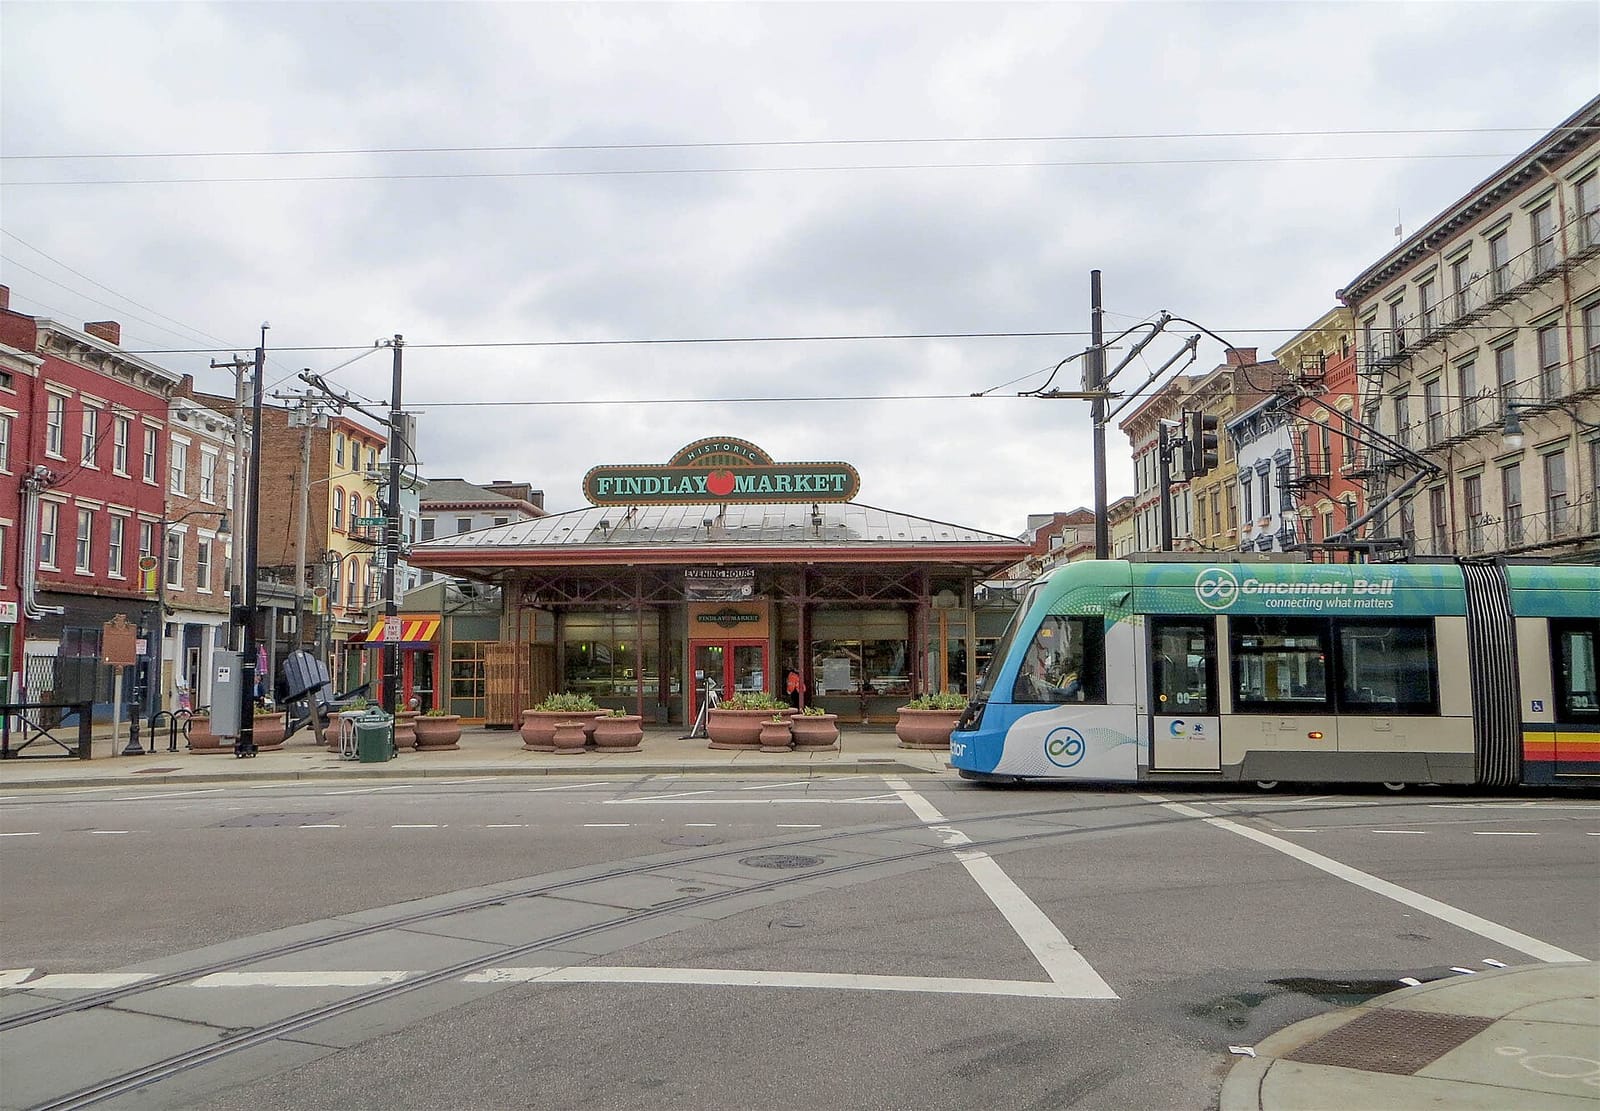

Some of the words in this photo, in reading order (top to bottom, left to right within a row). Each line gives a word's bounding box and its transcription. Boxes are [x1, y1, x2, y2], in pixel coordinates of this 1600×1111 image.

[687, 443, 757, 461] HISTORIC
[597, 474, 707, 496] FINDLAY
[733, 473, 847, 494] MARKET
[686, 569, 723, 577] EVENING
[725, 569, 753, 577] HOURS
[1241, 578, 1348, 595] Cincinnati
[1352, 579, 1393, 595] Bell
[1265, 598, 1323, 610] connecting
[1326, 598, 1351, 608] what
[1353, 598, 1394, 609] matters
